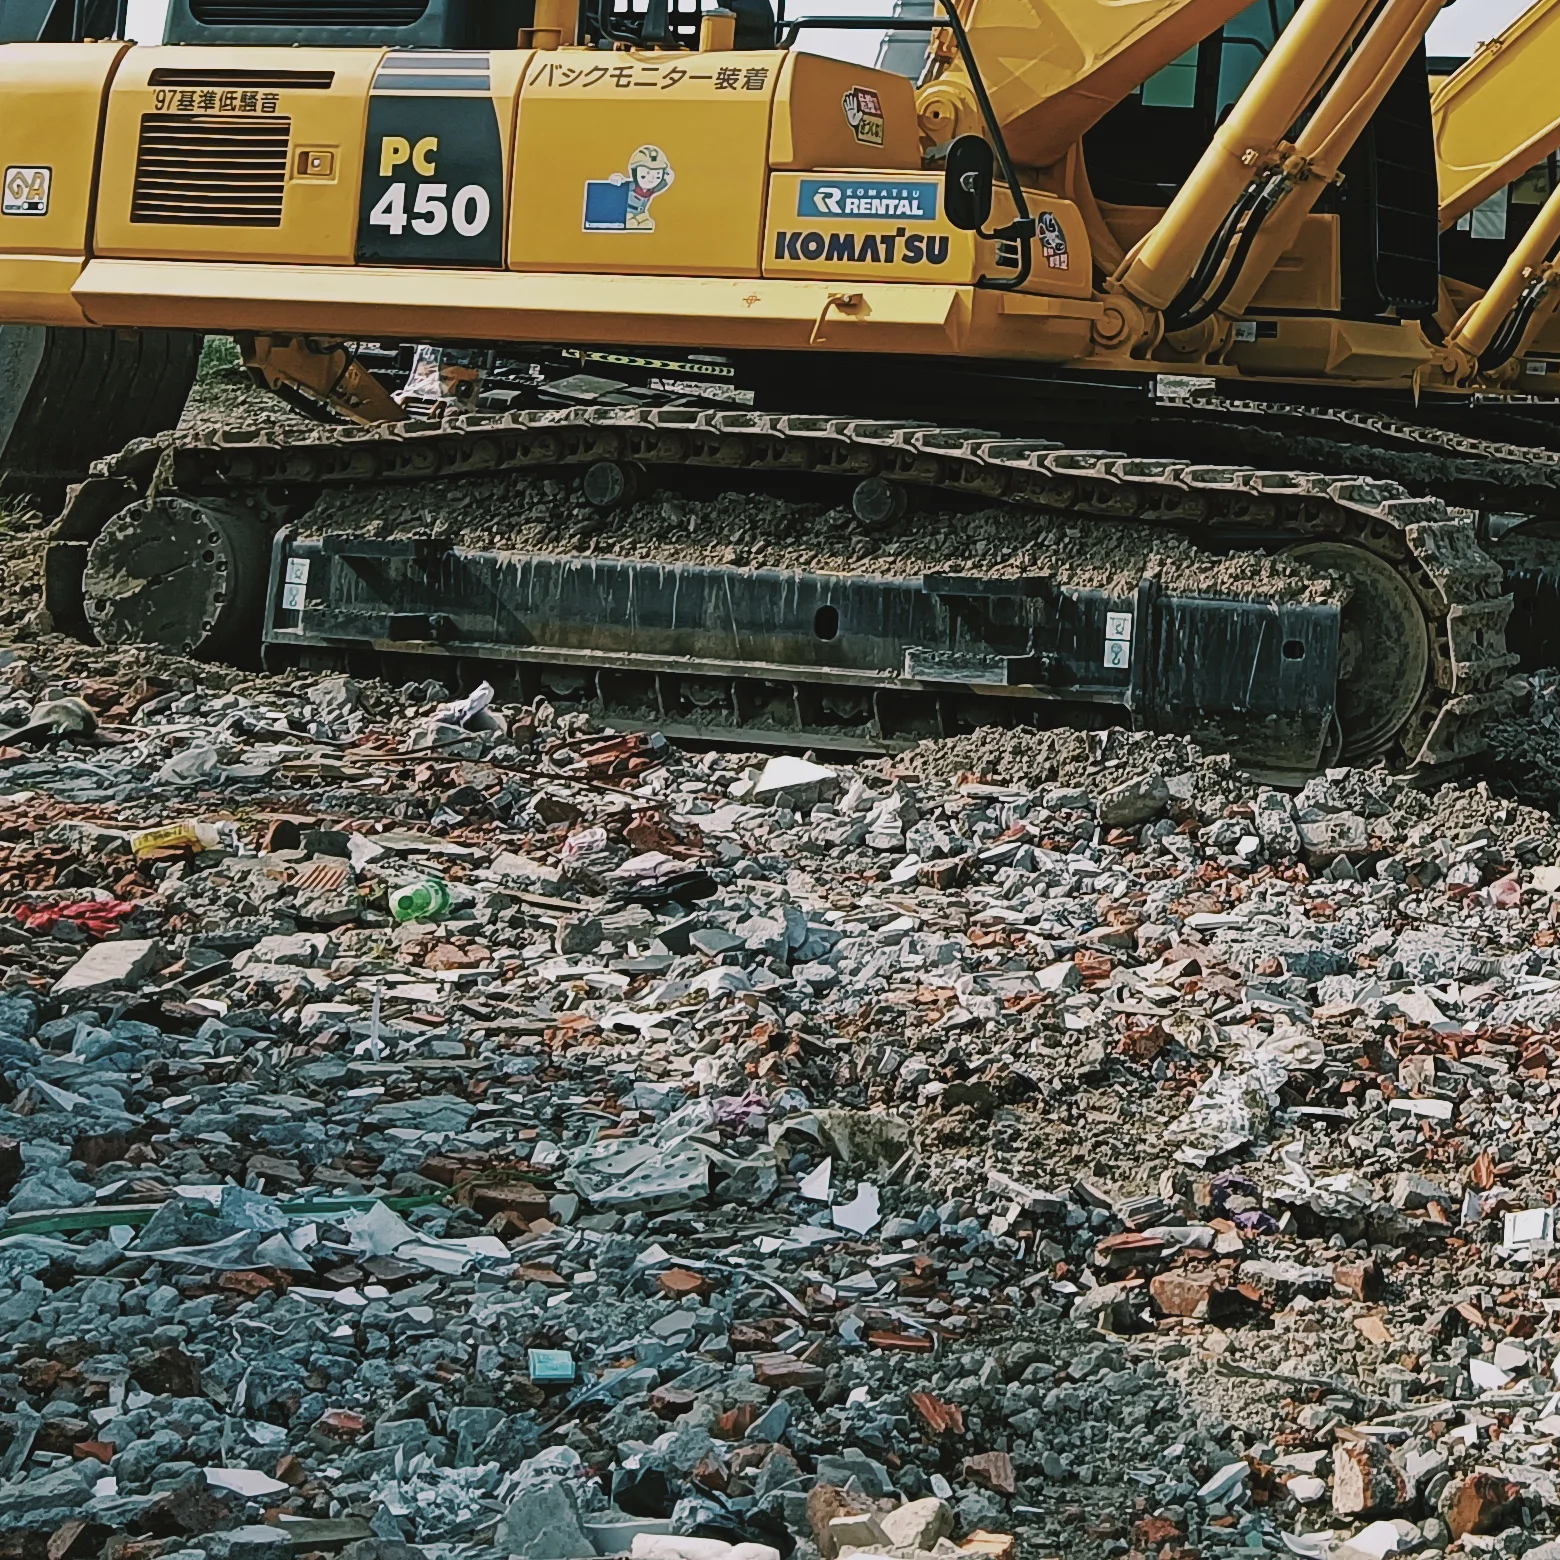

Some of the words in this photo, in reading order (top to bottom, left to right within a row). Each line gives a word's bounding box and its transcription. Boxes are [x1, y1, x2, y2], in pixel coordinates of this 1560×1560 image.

[379, 136, 438, 177] PC
[369, 182, 491, 237] 450
[844, 198, 924, 216] RENTAL
[846, 188, 920, 198] KOMATSU
[774, 226, 950, 265] KOMATSU
